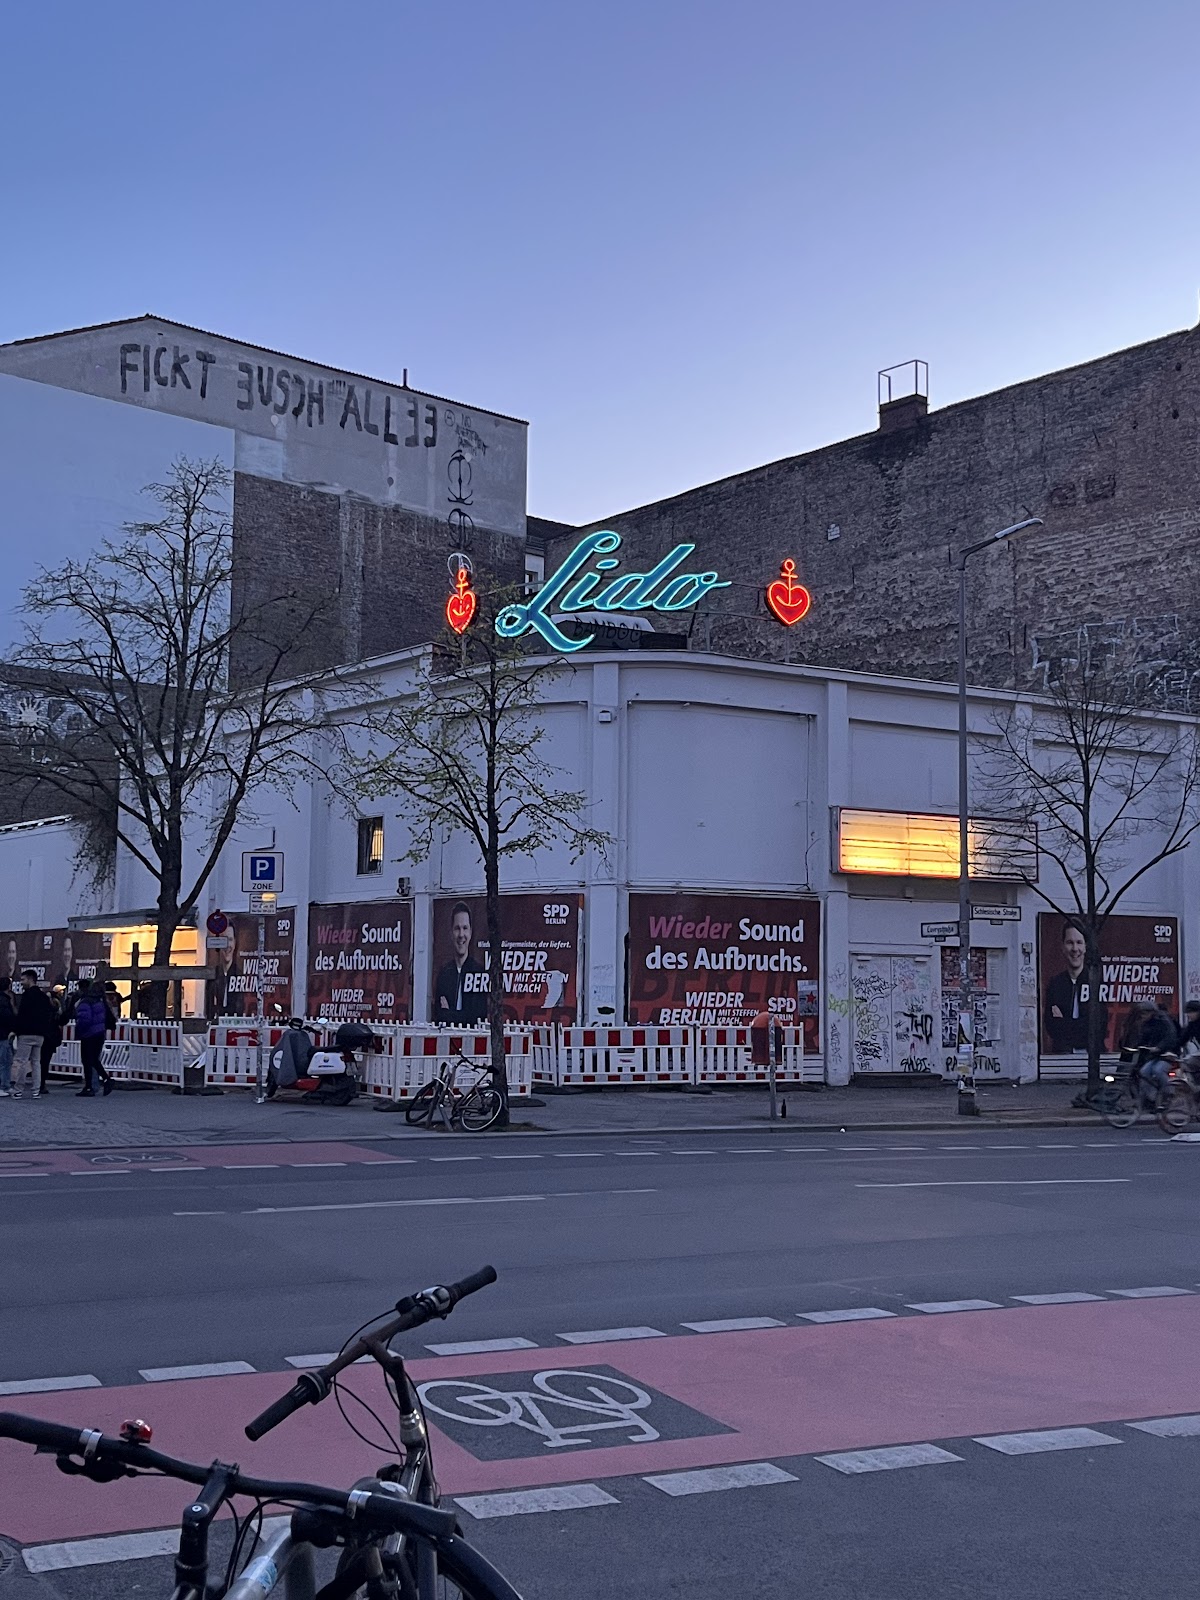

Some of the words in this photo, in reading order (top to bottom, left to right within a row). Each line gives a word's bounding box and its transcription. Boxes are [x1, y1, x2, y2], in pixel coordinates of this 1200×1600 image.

[119, 343, 216, 400] FICKT
[494, 529, 732, 653] Lido
[256, 859, 269, 878] P
[543, 904, 570, 918] SPD
[277, 919, 291, 931] SPD
[317, 924, 359, 944] Wieder
[361, 920, 401, 944] Sound
[648, 914, 733, 940] Wieder
[738, 917, 804, 943] Sound
[1154, 925, 1172, 937] SPD
[538, 940, 549, 948] der
[549, 940, 571, 950] liefert.
[315, 949, 334, 970] des
[336, 948, 403, 970] Aufbruchs.
[645, 944, 688, 970] des
[693, 946, 808, 973] Aufbruchs.
[514, 973, 531, 982] MIT
[1102, 964, 1160, 983] WIEDER
[331, 988, 364, 1003] WIEDER
[512, 983, 541, 993] KRACH
[1080, 984, 1133, 1002] BRLIN
[1133, 985, 1148, 994] MIT
[1148, 985, 1174, 994] STEFFEN
[377, 992, 395, 1007] SPD
[685, 991, 745, 1008] WIEDER
[768, 996, 797, 1013] SPD
[320, 1003, 347, 1017] BERLIN
[659, 1008, 717, 1025] BERLIN
